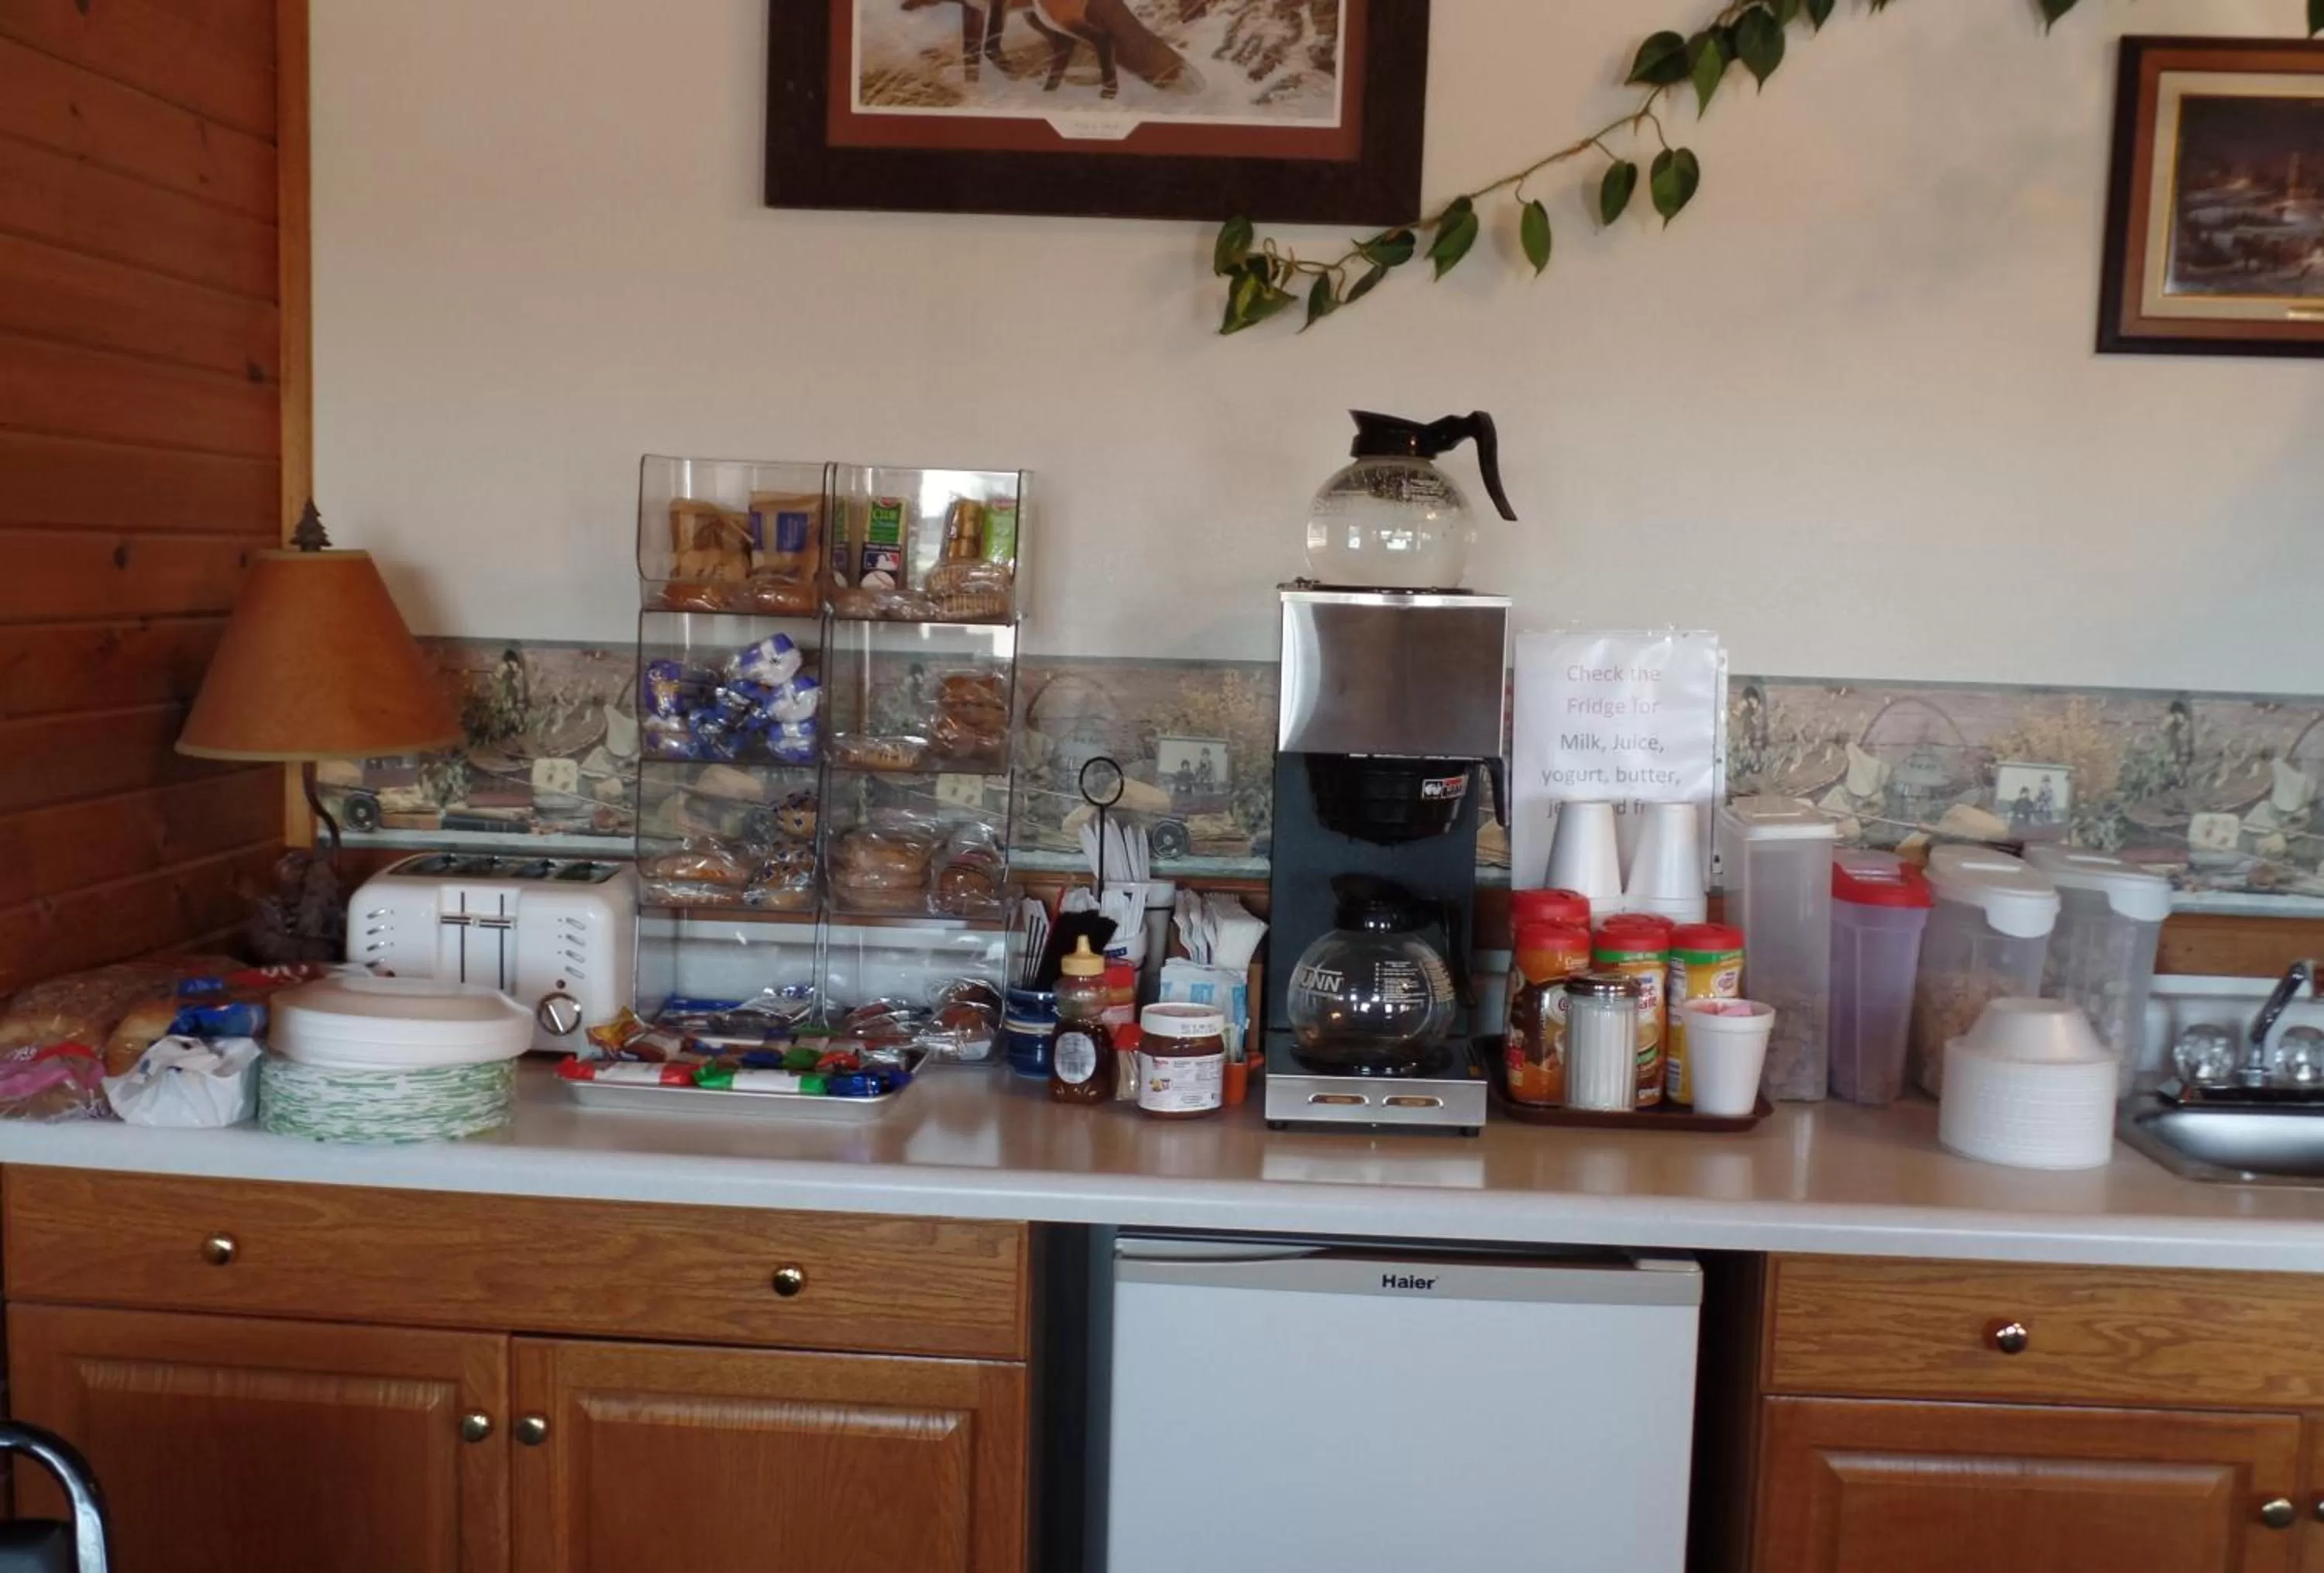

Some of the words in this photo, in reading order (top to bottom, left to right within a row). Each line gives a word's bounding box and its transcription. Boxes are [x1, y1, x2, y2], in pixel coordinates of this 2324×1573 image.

[1566, 665, 1624, 683] Check
[1630, 666, 1662, 683] the
[1566, 697, 1627, 718] Fridge
[1631, 697, 1662, 714] for
[1560, 734, 1607, 753] Milk,
[1611, 734, 1666, 754] Juice,
[1541, 769, 1610, 786] yogurt,
[1616, 766, 1682, 786] butter,
[1382, 1274, 1435, 1290] Haier
